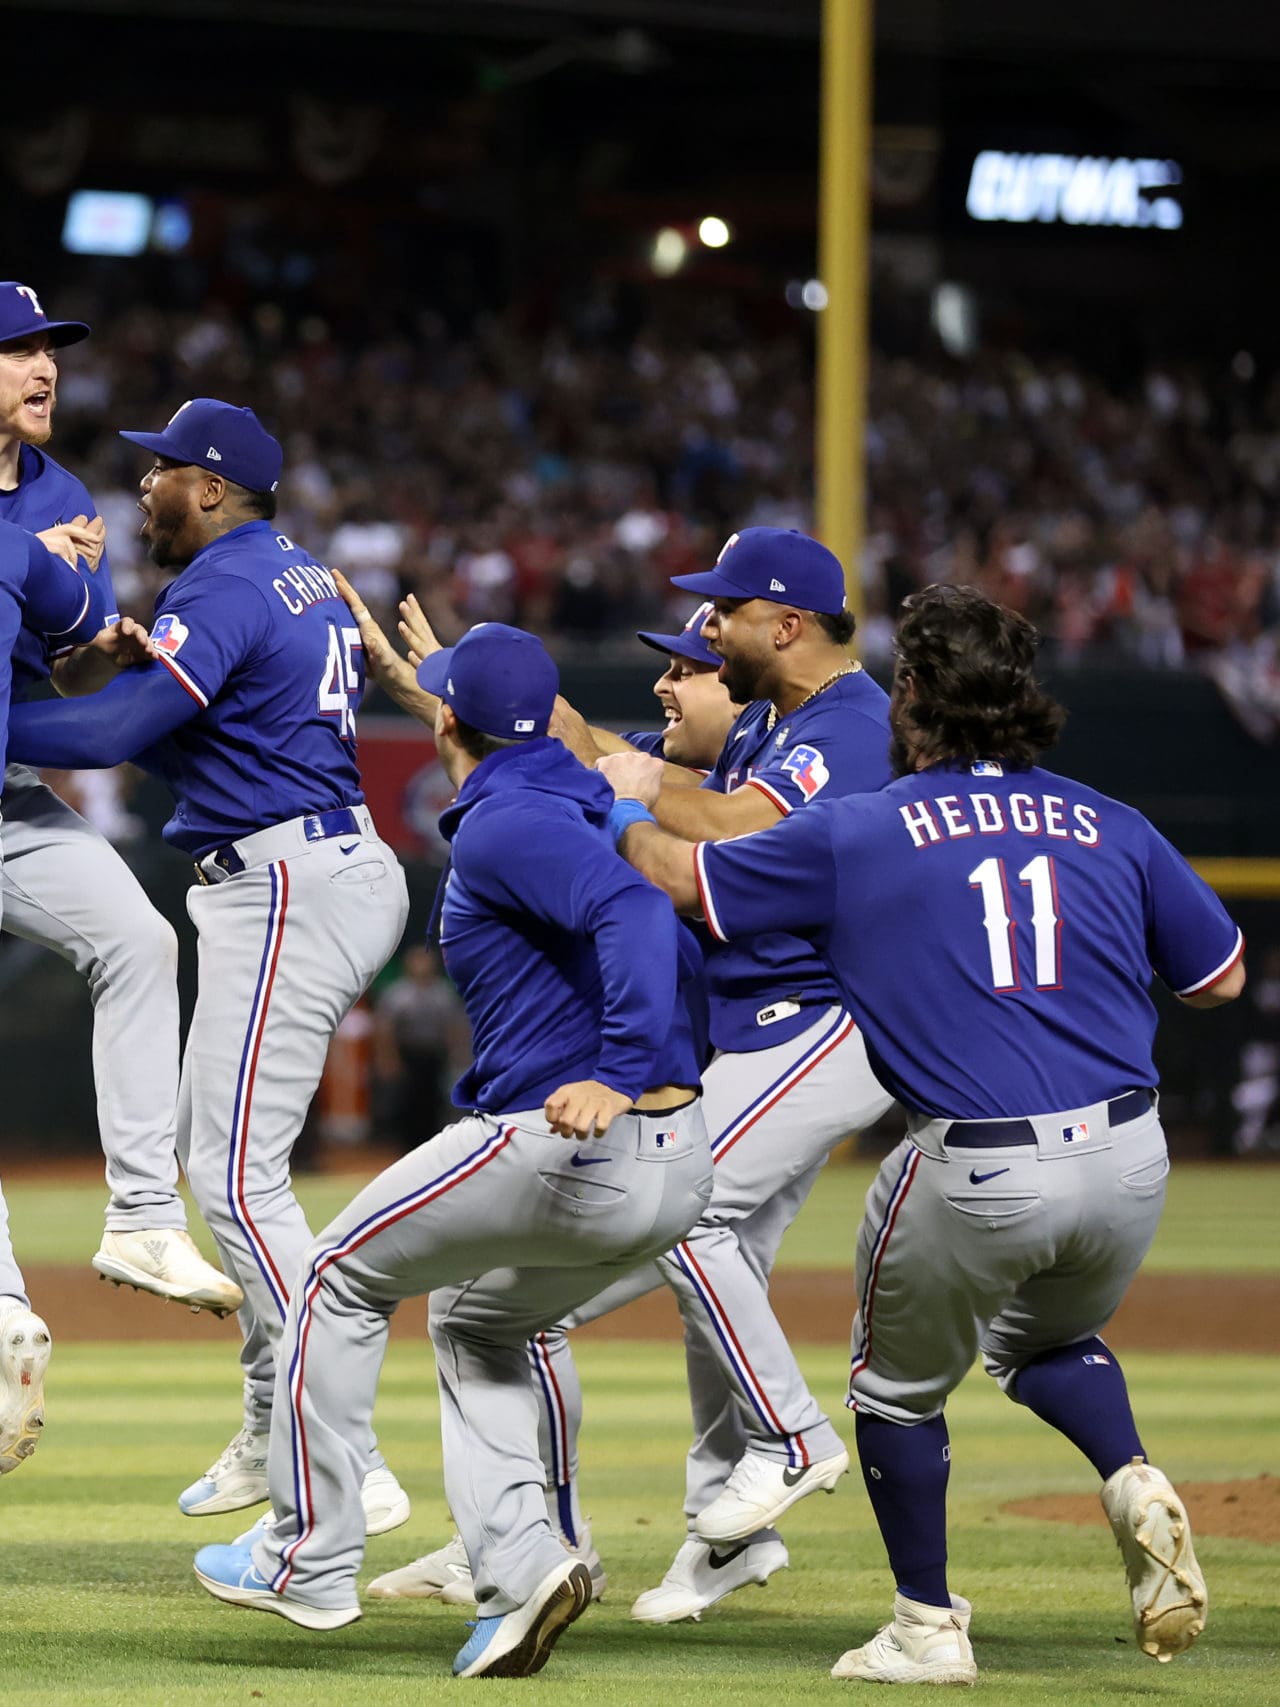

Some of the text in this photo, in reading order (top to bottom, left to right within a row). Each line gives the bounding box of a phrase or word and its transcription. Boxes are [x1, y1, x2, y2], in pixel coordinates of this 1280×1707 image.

[16, 285, 45, 317] T
[898, 793, 1102, 850] HEDGES
[968, 855, 1064, 994] 11
